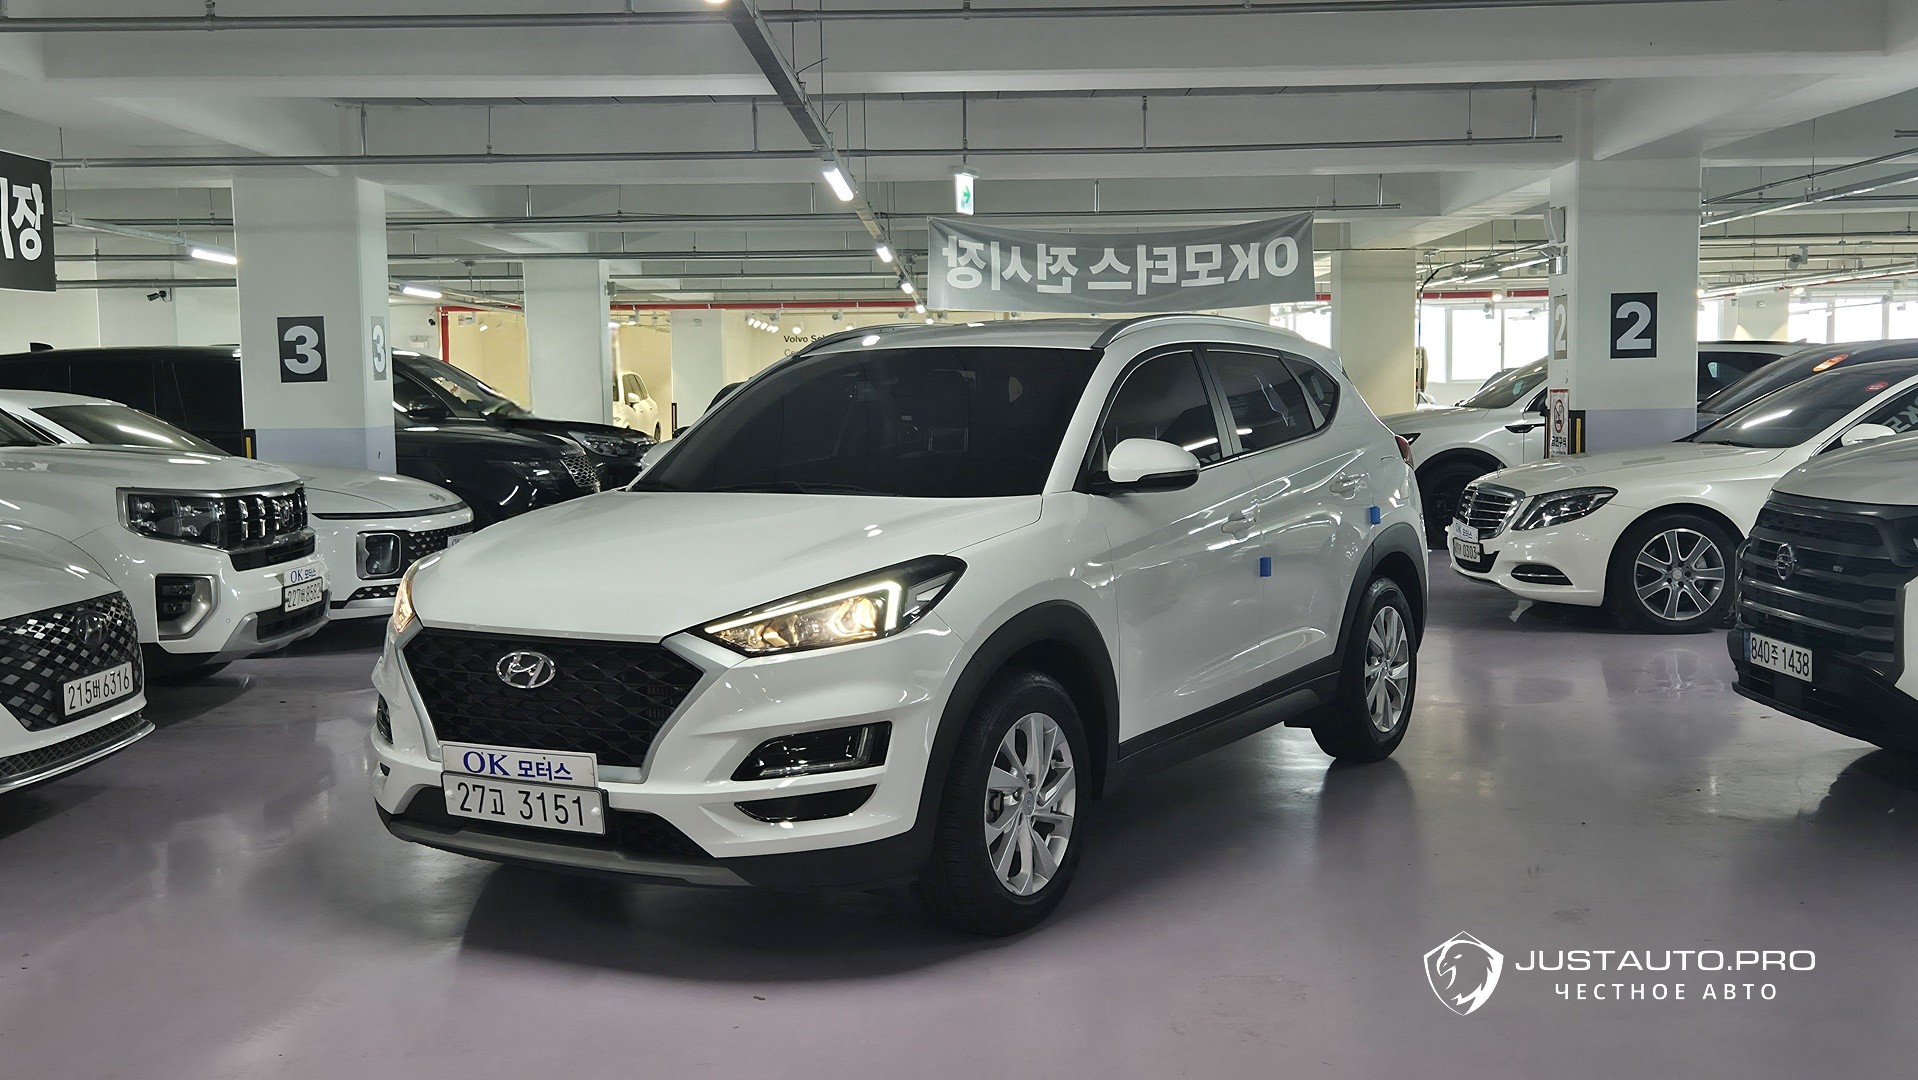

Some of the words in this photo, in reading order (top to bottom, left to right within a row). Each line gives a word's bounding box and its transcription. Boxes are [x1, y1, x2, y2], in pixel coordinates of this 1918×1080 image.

[372, 324, 386, 373] 3
[783, 335, 809, 343] Volvo
[1554, 303, 1567, 352] 2
[1615, 301, 1652, 350] 2
[283, 325, 322, 375] 3
[290, 568, 304, 583] OK
[463, 751, 511, 777] OK
[517, 759, 573, 781] 모터스
[457, 782, 506, 816] 27고
[517, 789, 584, 827] 3151
